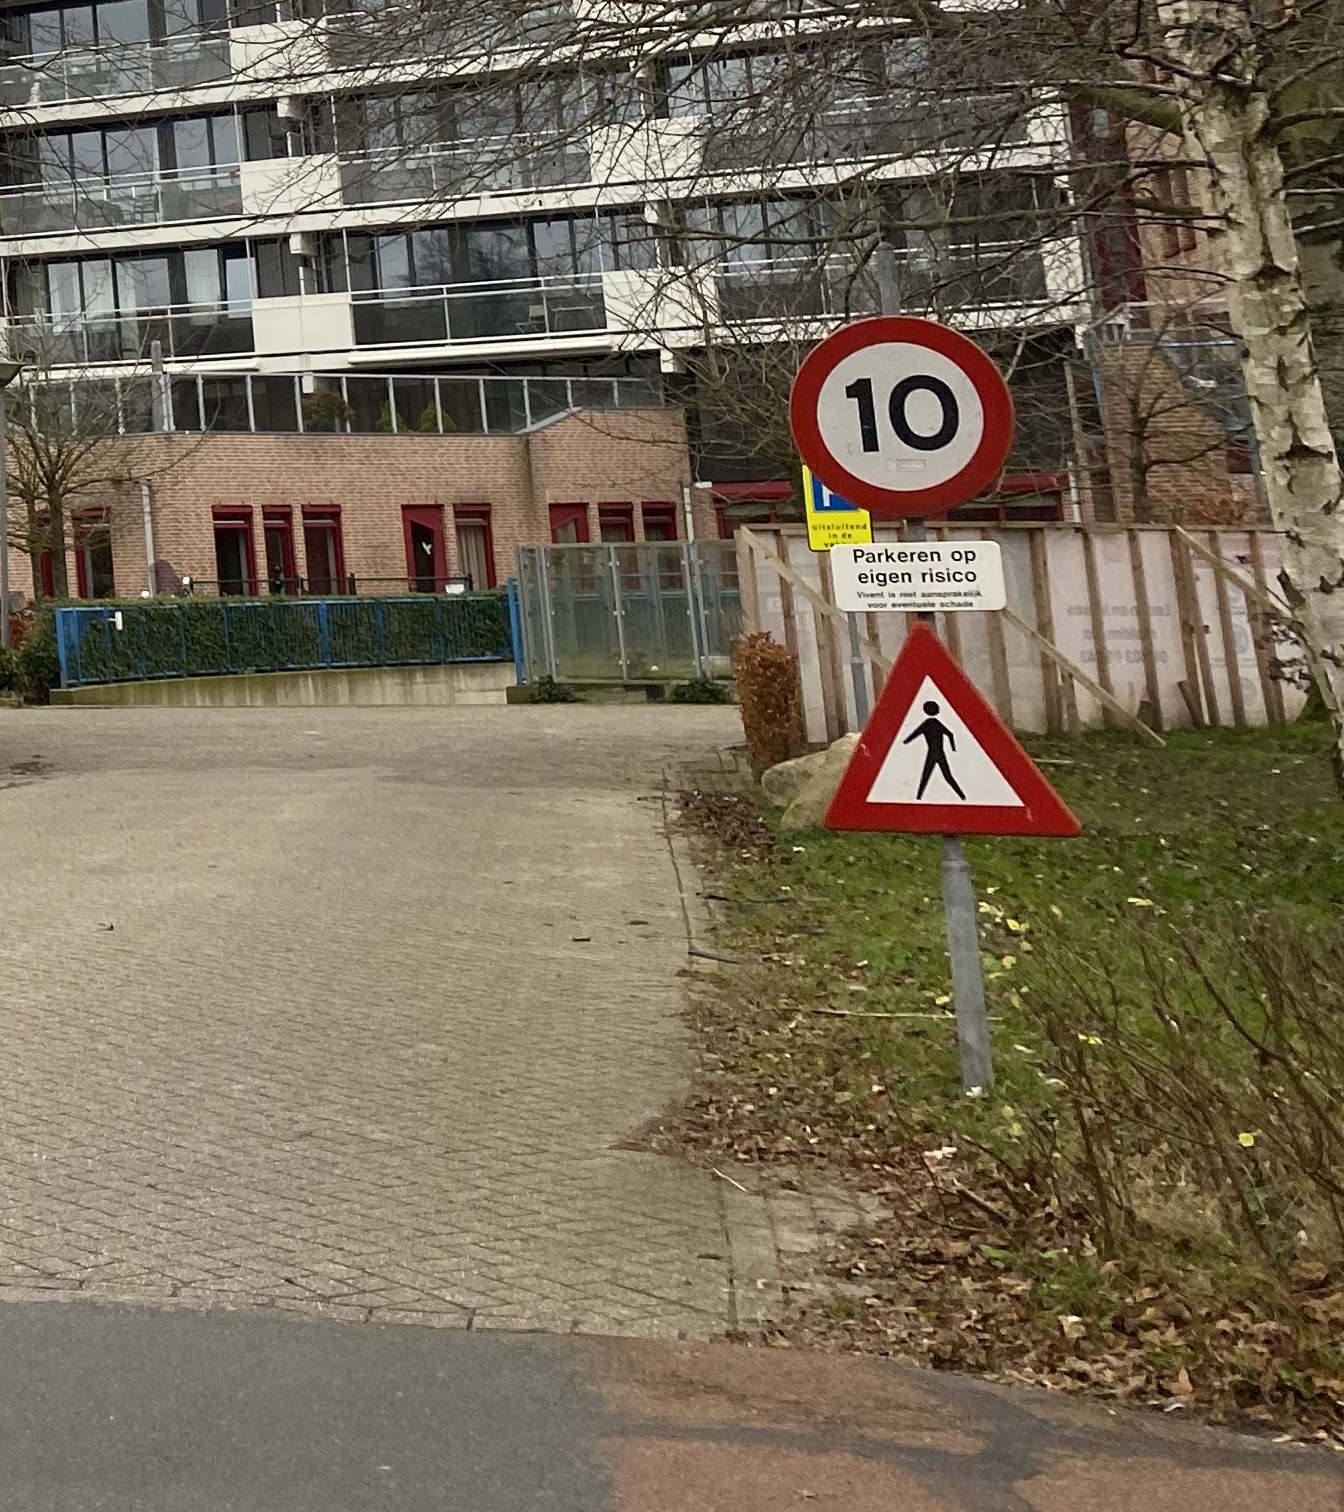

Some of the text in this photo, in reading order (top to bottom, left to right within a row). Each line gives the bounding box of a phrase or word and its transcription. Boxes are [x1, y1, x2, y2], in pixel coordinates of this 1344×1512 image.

[845, 374, 960, 453] 10
[812, 523, 867, 531] uitsluitend
[853, 548, 977, 565] Parkeren op
[857, 567, 978, 587] eigen risico
